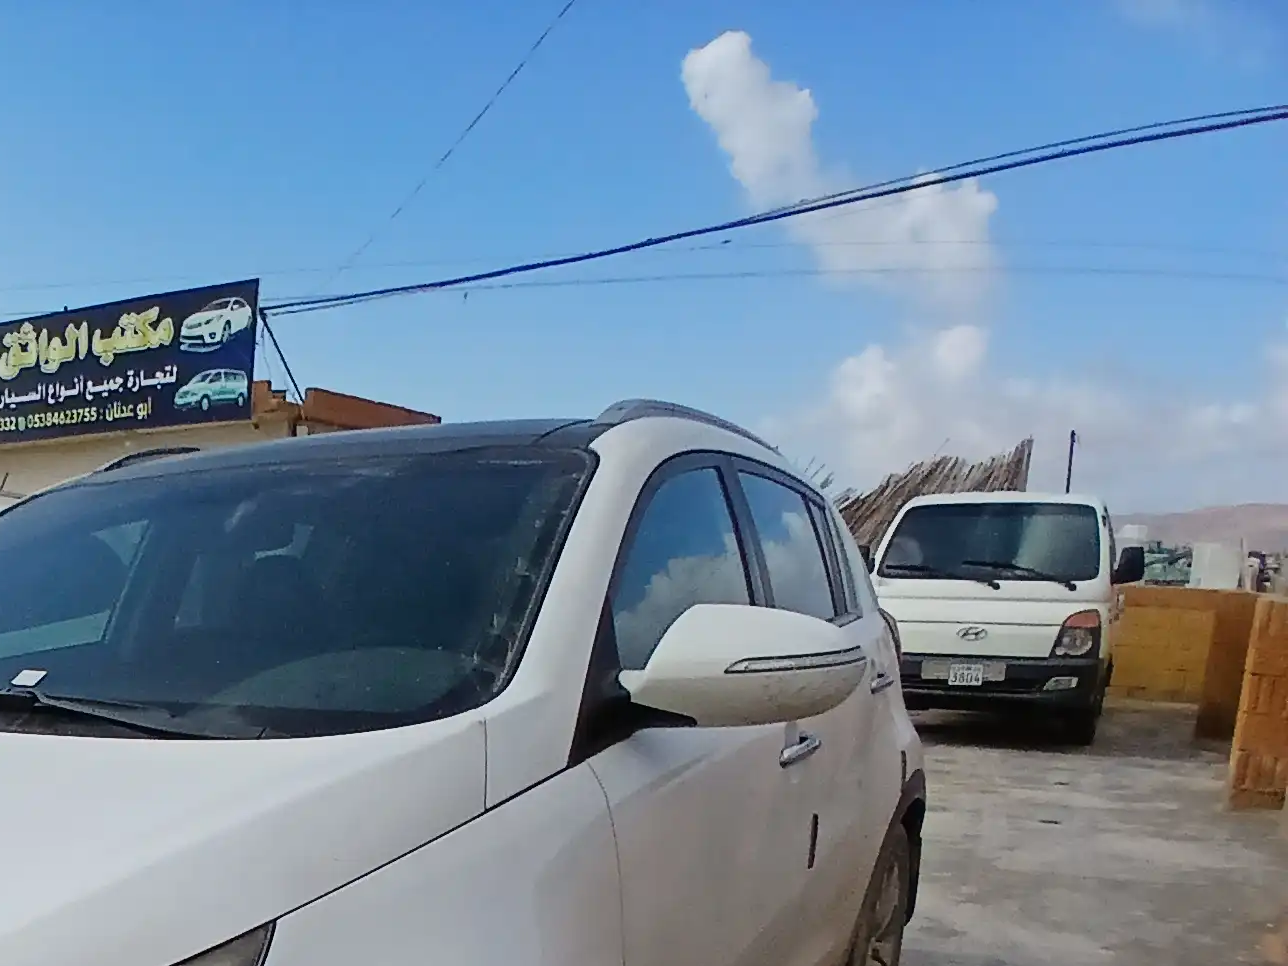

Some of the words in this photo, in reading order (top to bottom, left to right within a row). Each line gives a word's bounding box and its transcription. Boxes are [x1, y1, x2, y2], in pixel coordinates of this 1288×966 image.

[0, 320, 89, 380] الواثق
[92, 306, 174, 366] مكتب
[85, 376, 124, 401] جميع
[127, 364, 178, 393] لتجارة
